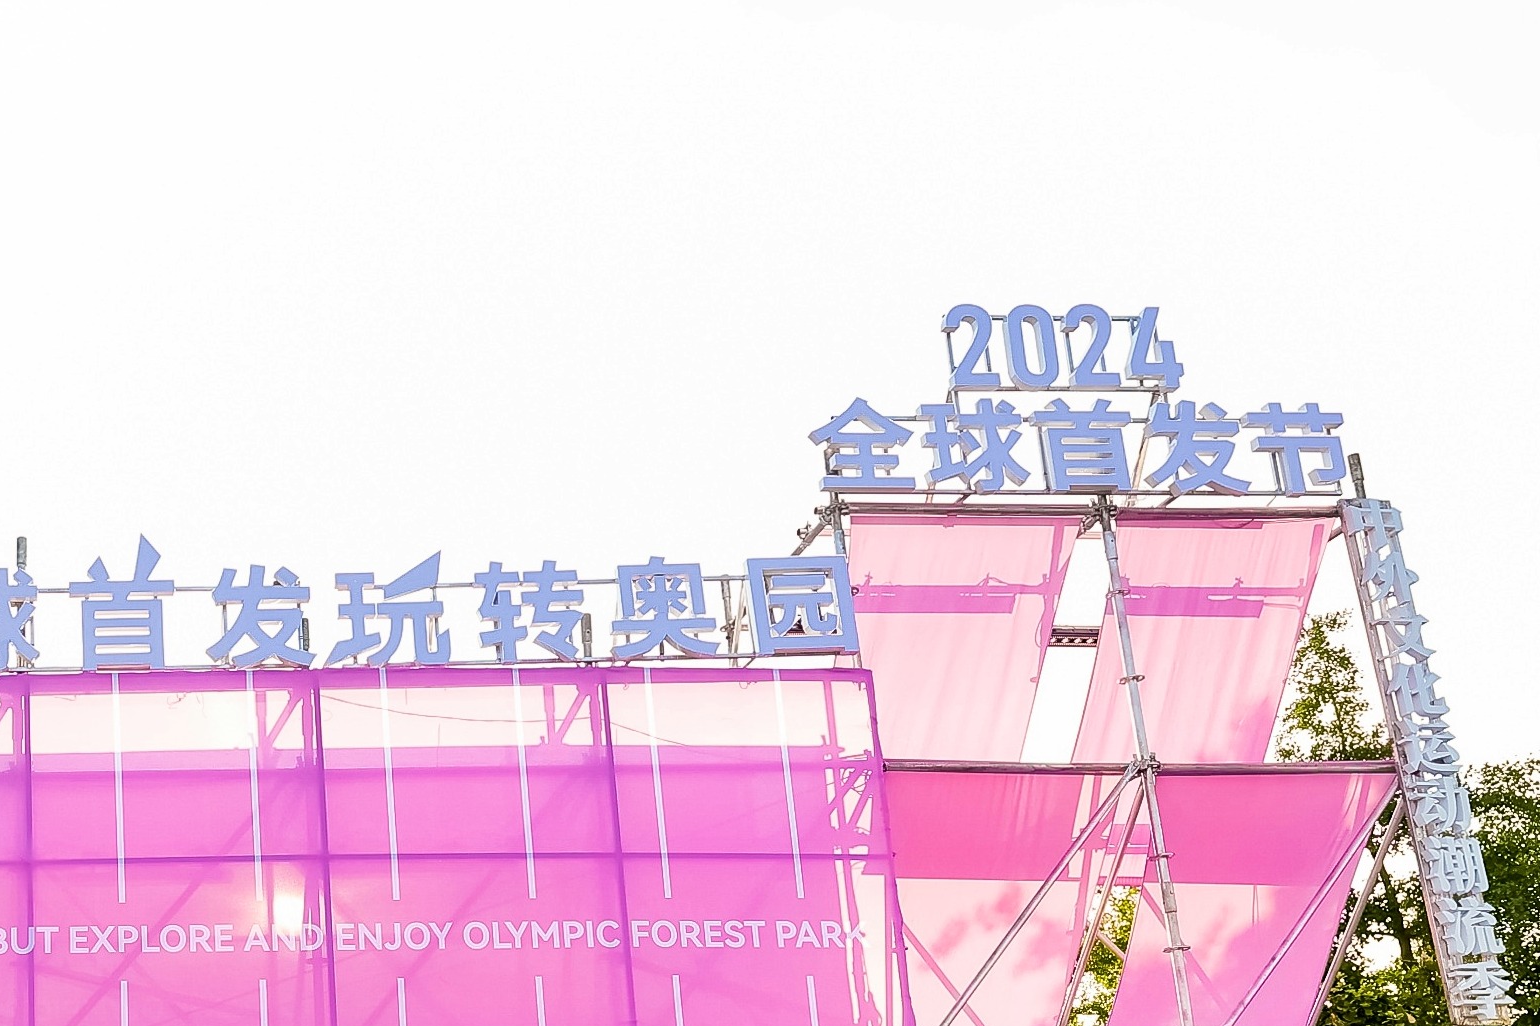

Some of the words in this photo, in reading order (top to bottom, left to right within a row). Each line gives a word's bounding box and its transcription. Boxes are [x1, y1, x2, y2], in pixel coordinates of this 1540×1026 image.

[946, 302, 1184, 391] 2024
[808, 396, 1348, 498] 全球首发节
[1345, 498, 1515, 1024] 中外文化运动潮流季
[68, 923, 235, 955] EXPLORE
[243, 921, 325, 953] AND
[335, 921, 453, 953] ENJOY
[461, 919, 622, 951] OLYMPIC
[630, 919, 766, 950] FOREST
[774, 918, 868, 950] PARK
